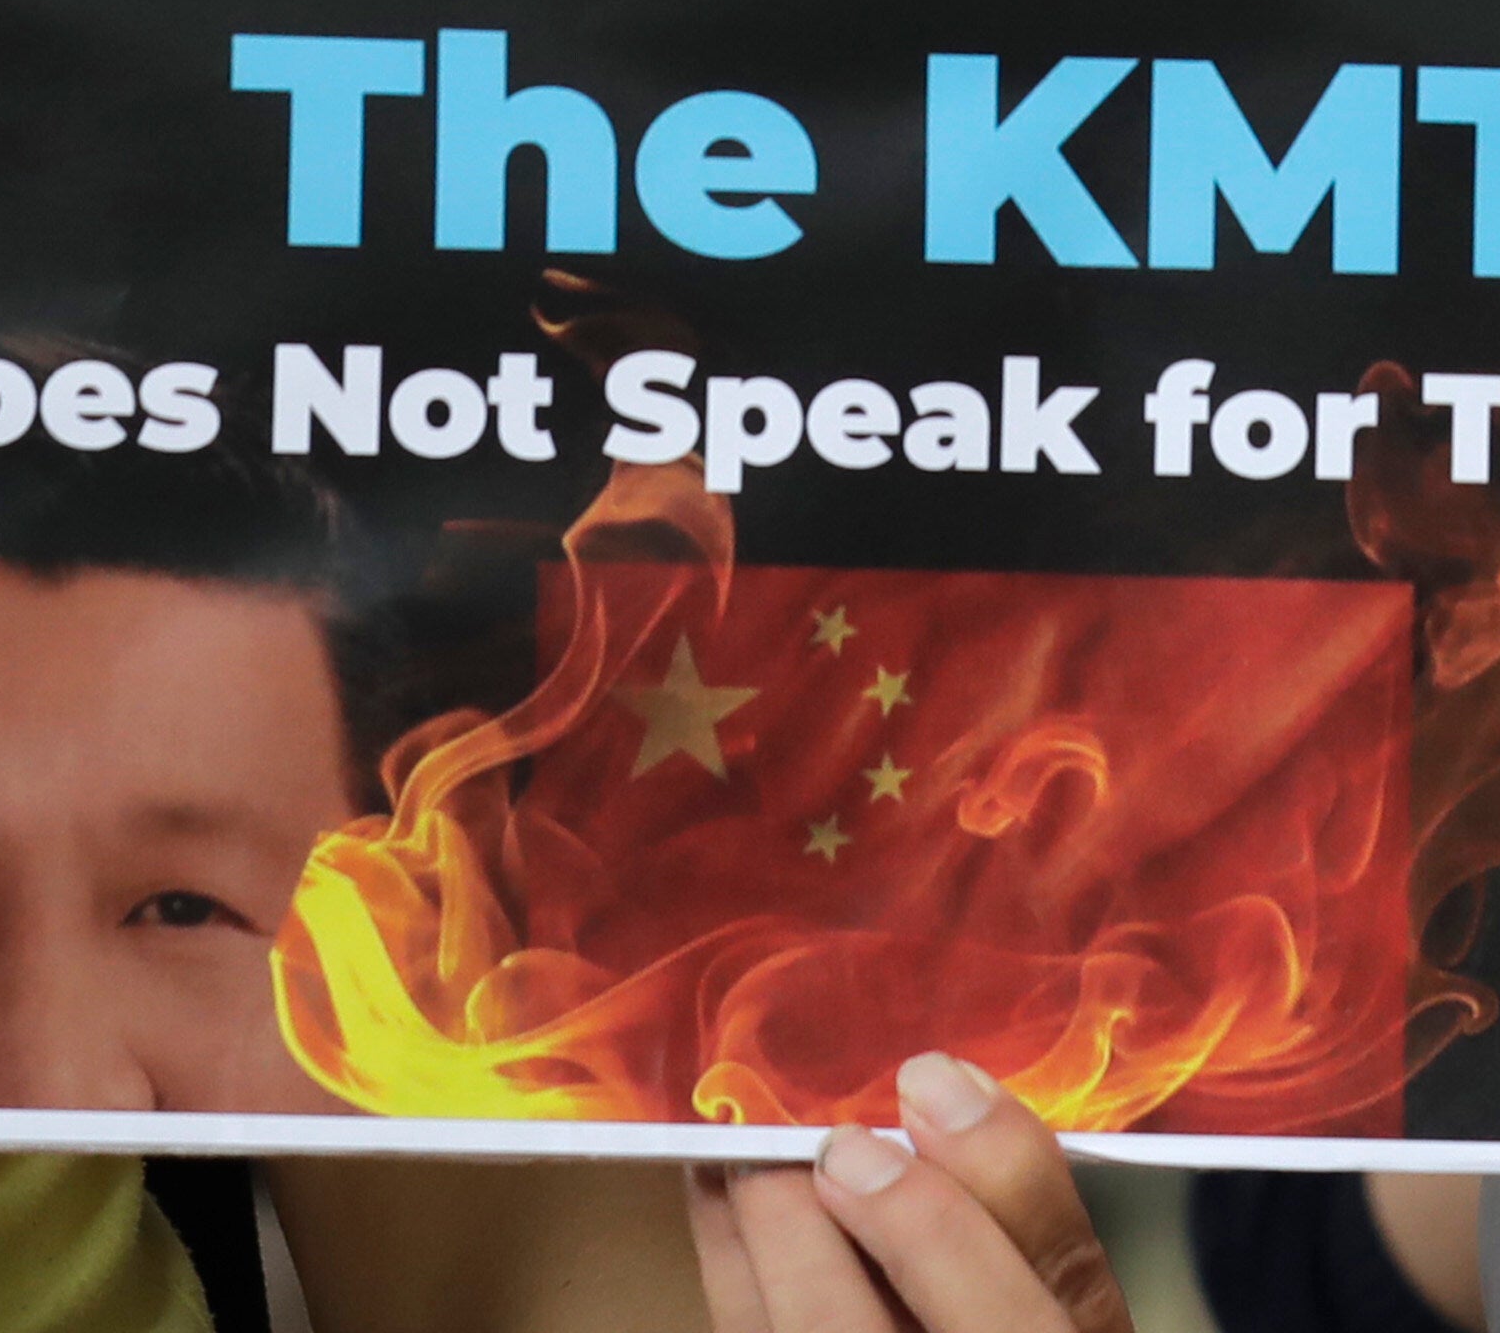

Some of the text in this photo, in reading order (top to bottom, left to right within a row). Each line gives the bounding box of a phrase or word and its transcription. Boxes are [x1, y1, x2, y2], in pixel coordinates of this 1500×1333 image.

[232, 29, 816, 258] The
[273, 344, 555, 460] Not
[604, 351, 1099, 492] Speak
[1145, 360, 1378, 479] for
